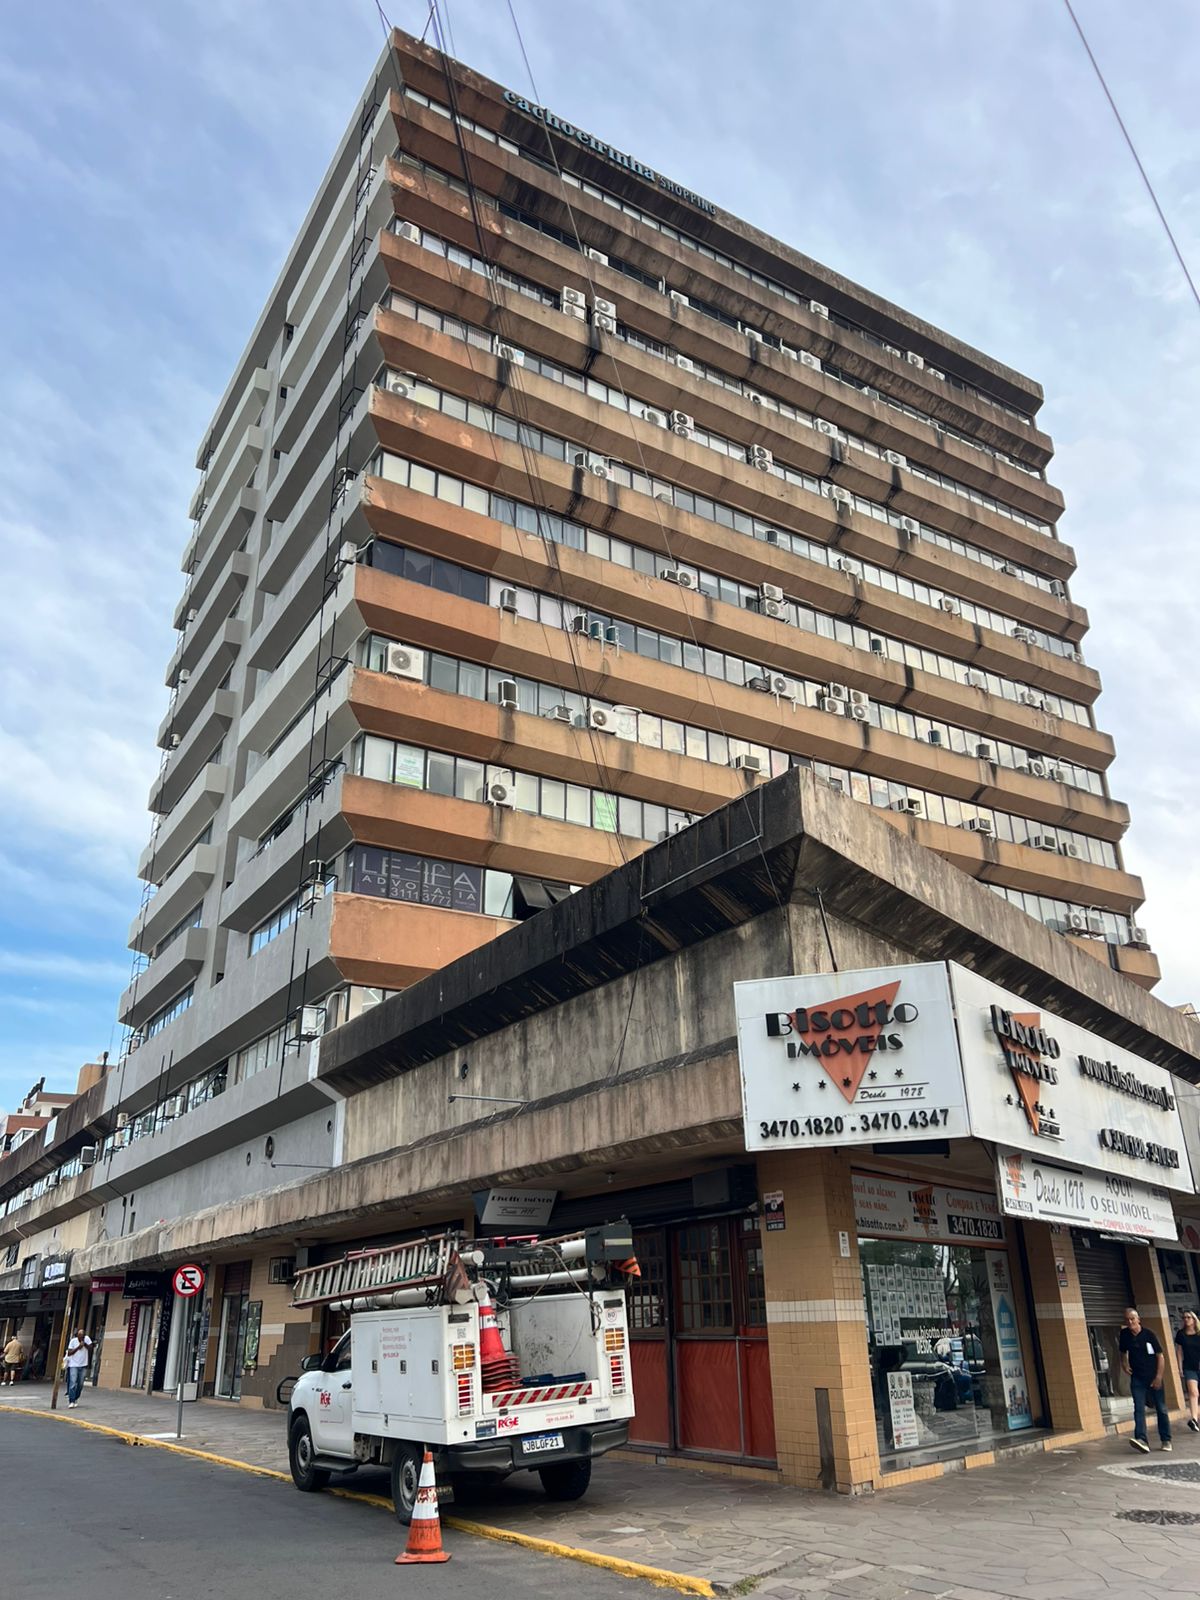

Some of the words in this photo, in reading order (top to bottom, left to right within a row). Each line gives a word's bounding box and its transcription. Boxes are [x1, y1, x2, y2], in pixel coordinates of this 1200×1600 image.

[659, 176, 717, 216] SHOPPING
[765, 1000, 919, 1038] Bisotto
[860, 1090, 887, 1100] Desde
[900, 1087, 925, 1098] 1978
[760, 1116, 845, 1139] 3470.1820
[860, 1109, 950, 1133] 3470.4347
[1033, 1168, 1061, 1206] Desde
[1064, 1179, 1086, 1210] 1978
[1105, 1176, 1134, 1199] AQUI!
[1101, 1197, 1119, 1215] SEU
[951, 1216, 999, 1238] 3470.1820
[890, 1389, 912, 1400] POLICIAL
[497, 1416, 519, 1430] RGE
